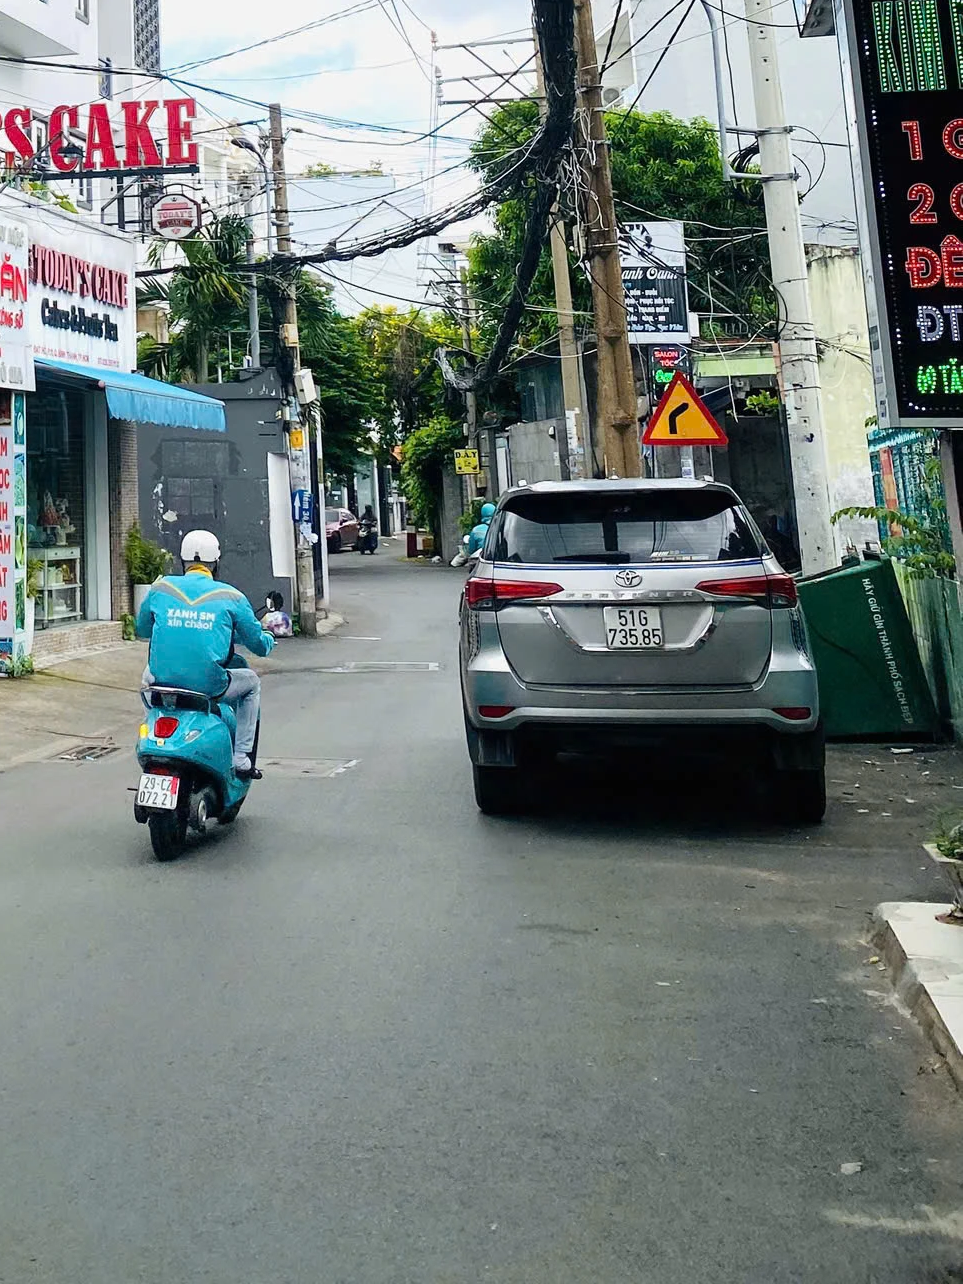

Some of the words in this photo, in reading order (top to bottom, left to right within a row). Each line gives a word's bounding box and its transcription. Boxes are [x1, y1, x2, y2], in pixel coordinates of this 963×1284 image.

[48, 98, 199, 172] CAKE
[901, 121, 923, 160] 1
[907, 183, 937, 224] 2
[31, 244, 91, 298] TODAY'S
[92, 263, 129, 310] CAKE
[622, 267, 643, 280] anh
[654, 350, 679, 358] SALON
[566, 590, 694, 598] FORTUNER
[862, 578, 875, 596] HÃY
[167, 608, 197, 620] XANH
[199, 611, 216, 622] SM
[167, 618, 183, 627] xin
[618, 610, 648, 627] 51G
[608, 629, 662, 646] 735.85
